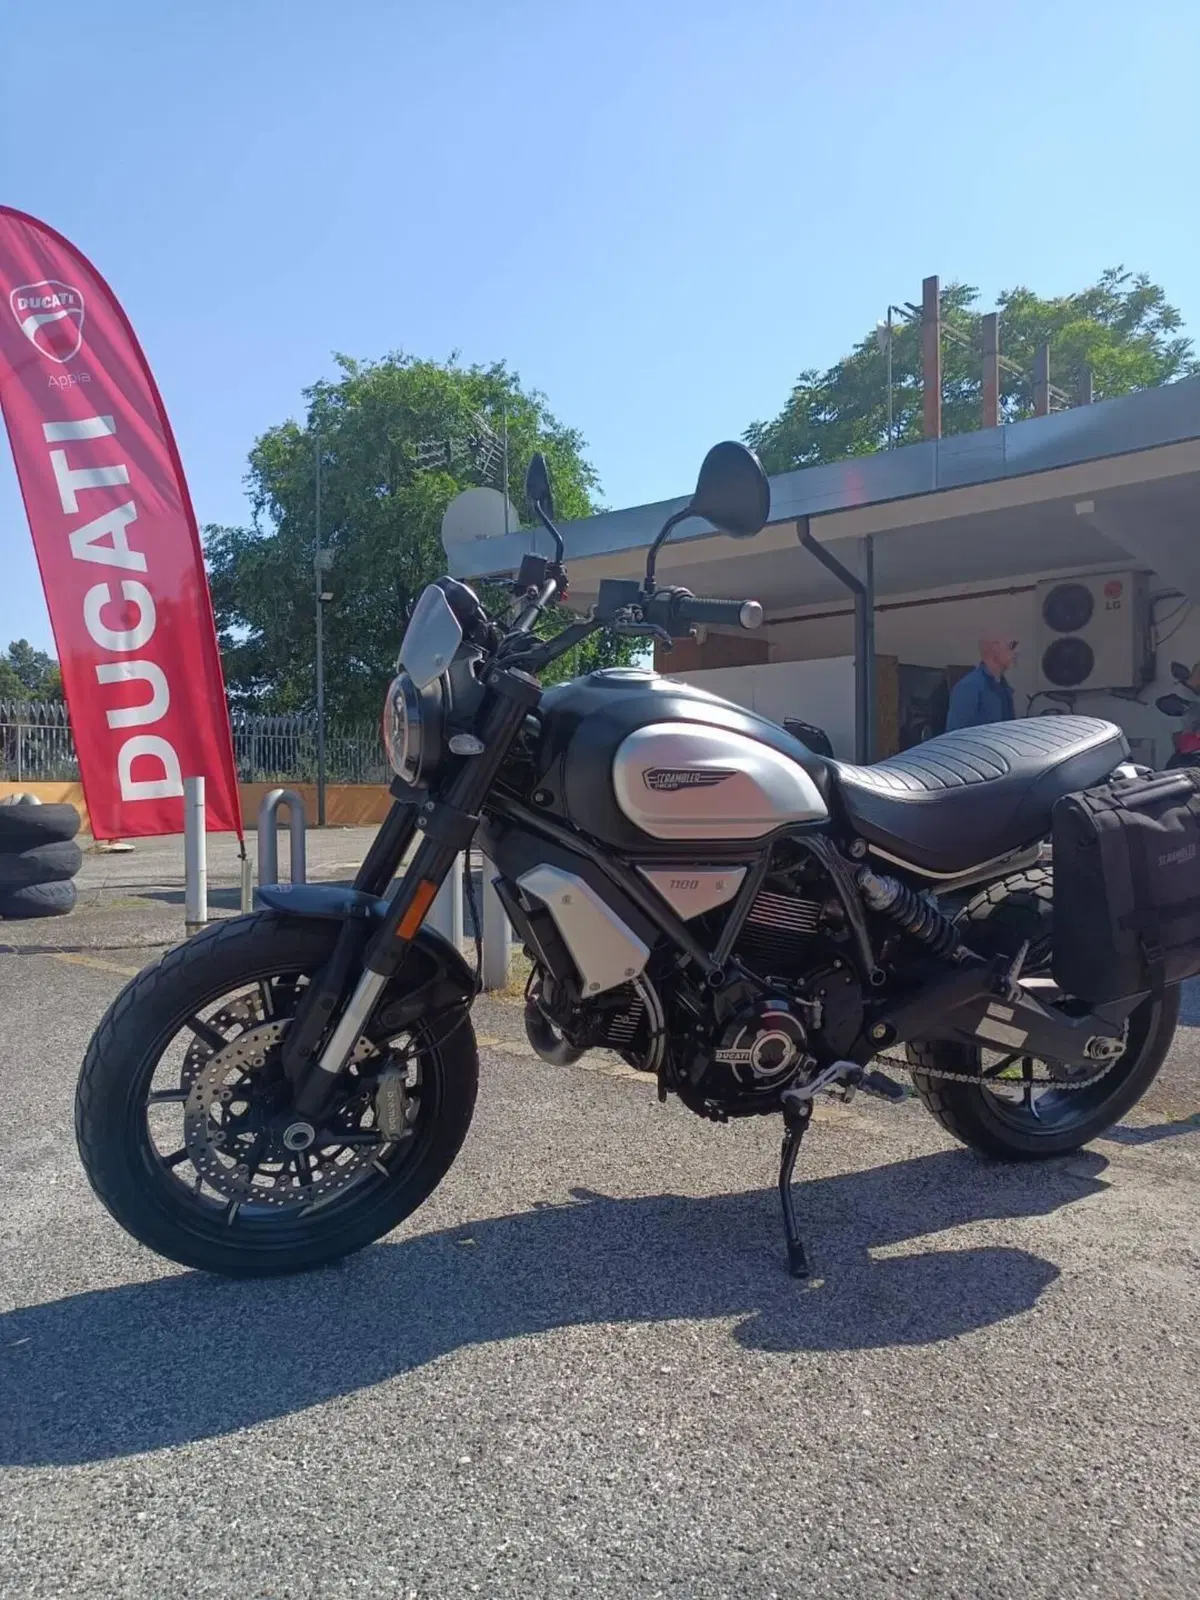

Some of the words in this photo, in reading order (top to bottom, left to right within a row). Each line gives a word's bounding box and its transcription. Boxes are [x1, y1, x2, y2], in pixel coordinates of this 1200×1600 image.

[17, 292, 75, 310] DUCATI
[47, 370, 91, 390] Appia
[42, 415, 185, 802] DUCATI
[1105, 600, 1121, 610] LG
[657, 772, 701, 783] SCRAMBLER
[669, 879, 700, 890] 1100
[715, 1052, 750, 1060] DUCATI
